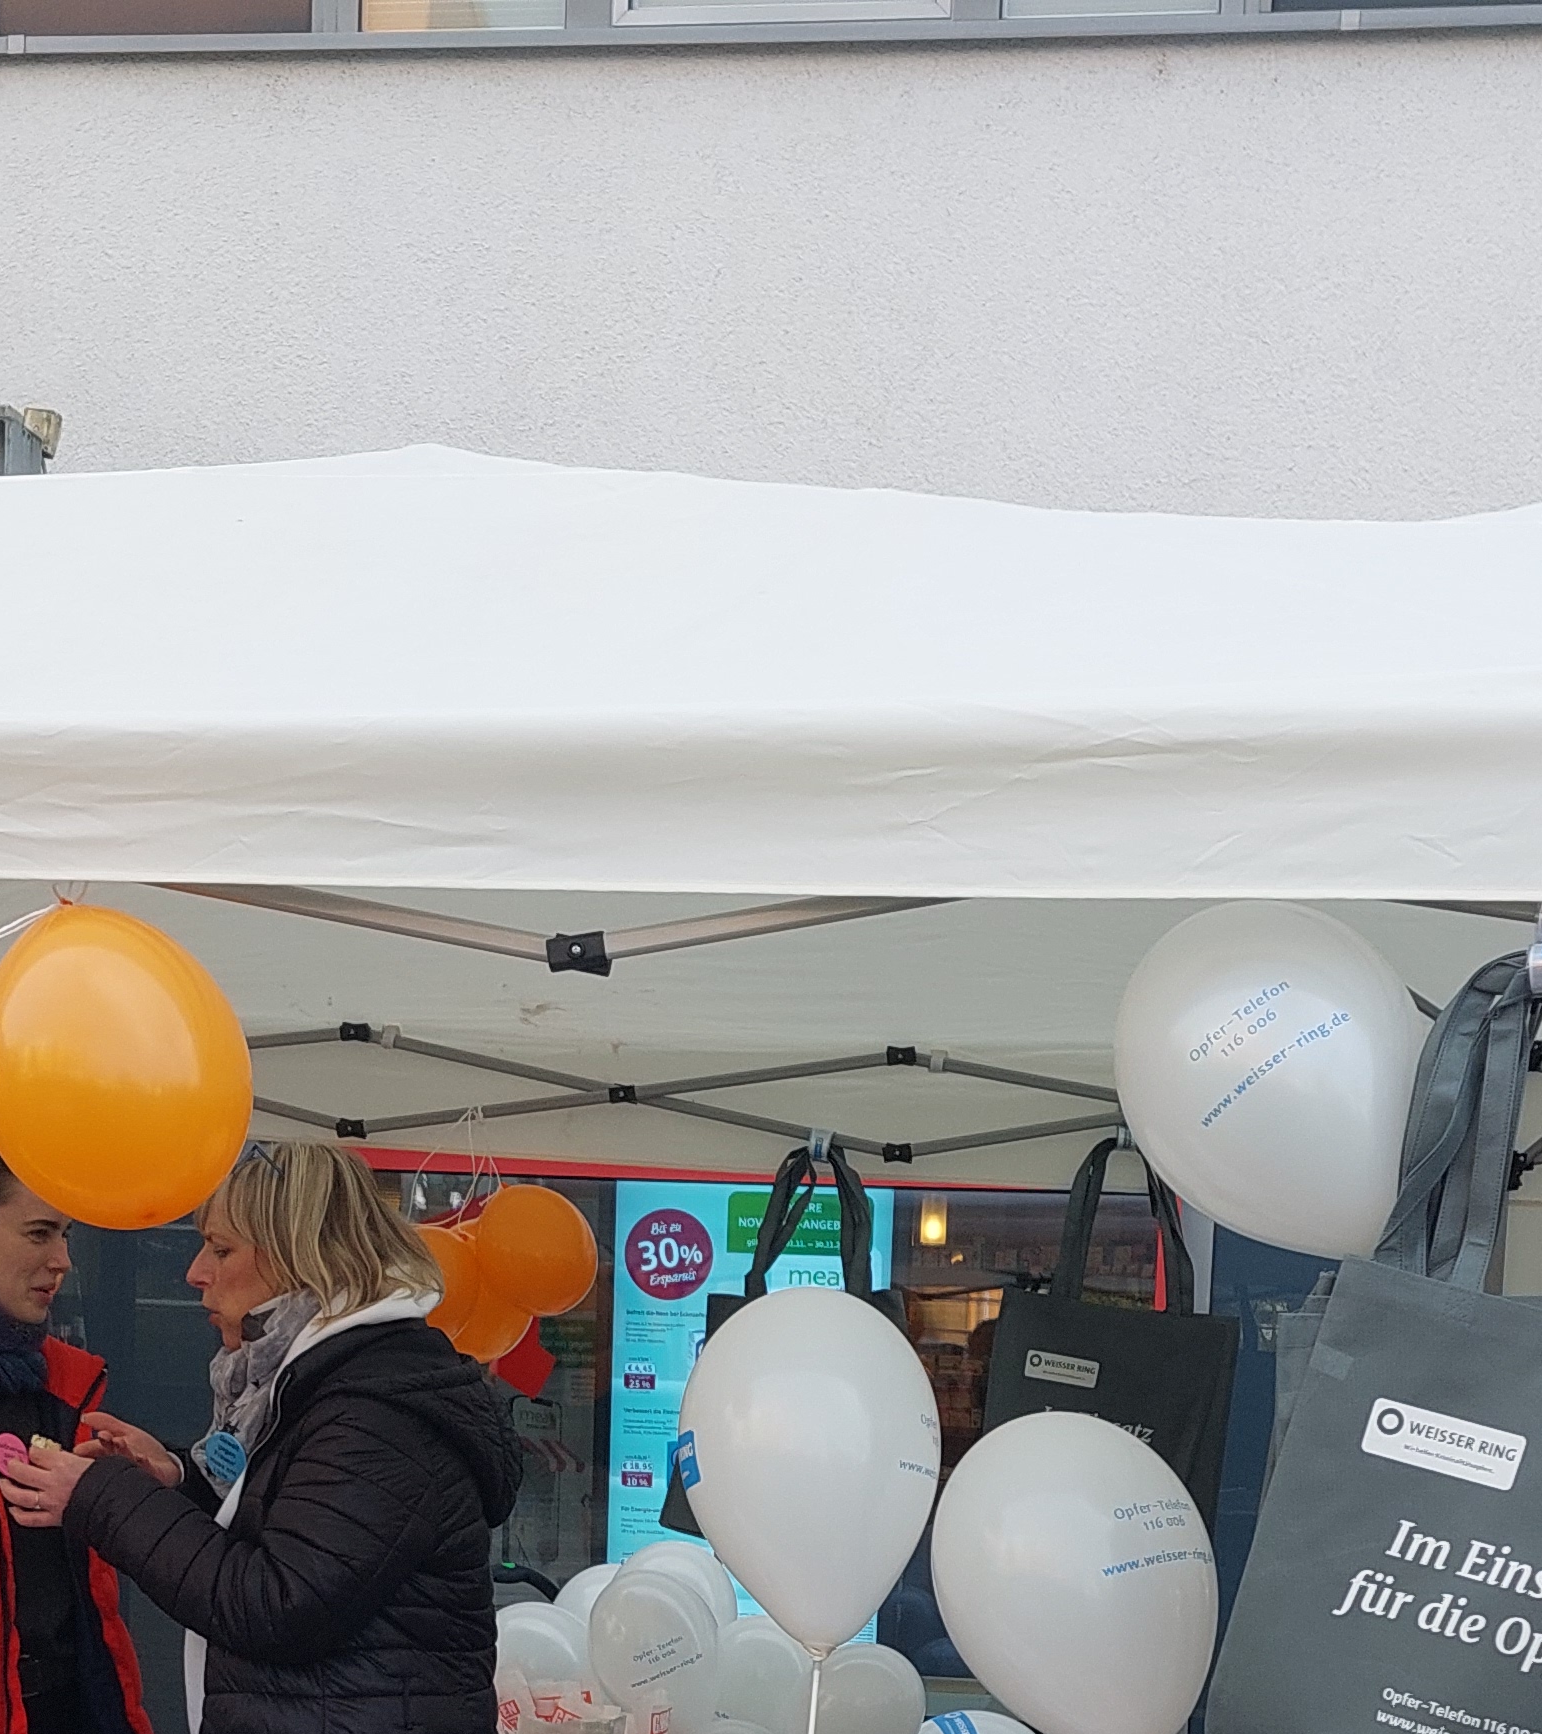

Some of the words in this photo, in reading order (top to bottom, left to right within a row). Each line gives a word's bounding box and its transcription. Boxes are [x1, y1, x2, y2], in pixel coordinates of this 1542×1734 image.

[1188, 978, 1291, 1063] Opfer-Telefon
[1220, 1034, 1245, 1058] 116
[1246, 1008, 1278, 1038] 006
[1199, 1009, 1352, 1129] www.weisser-ring.de
[638, 1237, 703, 1271] 30%
[1410, 1421, 1476, 1451] WEISSER
[1478, 1440, 1519, 1461] RING
[1114, 1500, 1192, 1521] Opfer-Telefon
[1143, 1516, 1163, 1531] 116
[1385, 1519, 1451, 1570] Im
[1331, 1569, 1415, 1619] für
[1417, 1593, 1487, 1643] die
[1382, 1687, 1481, 1728] Opfer-Telefon
